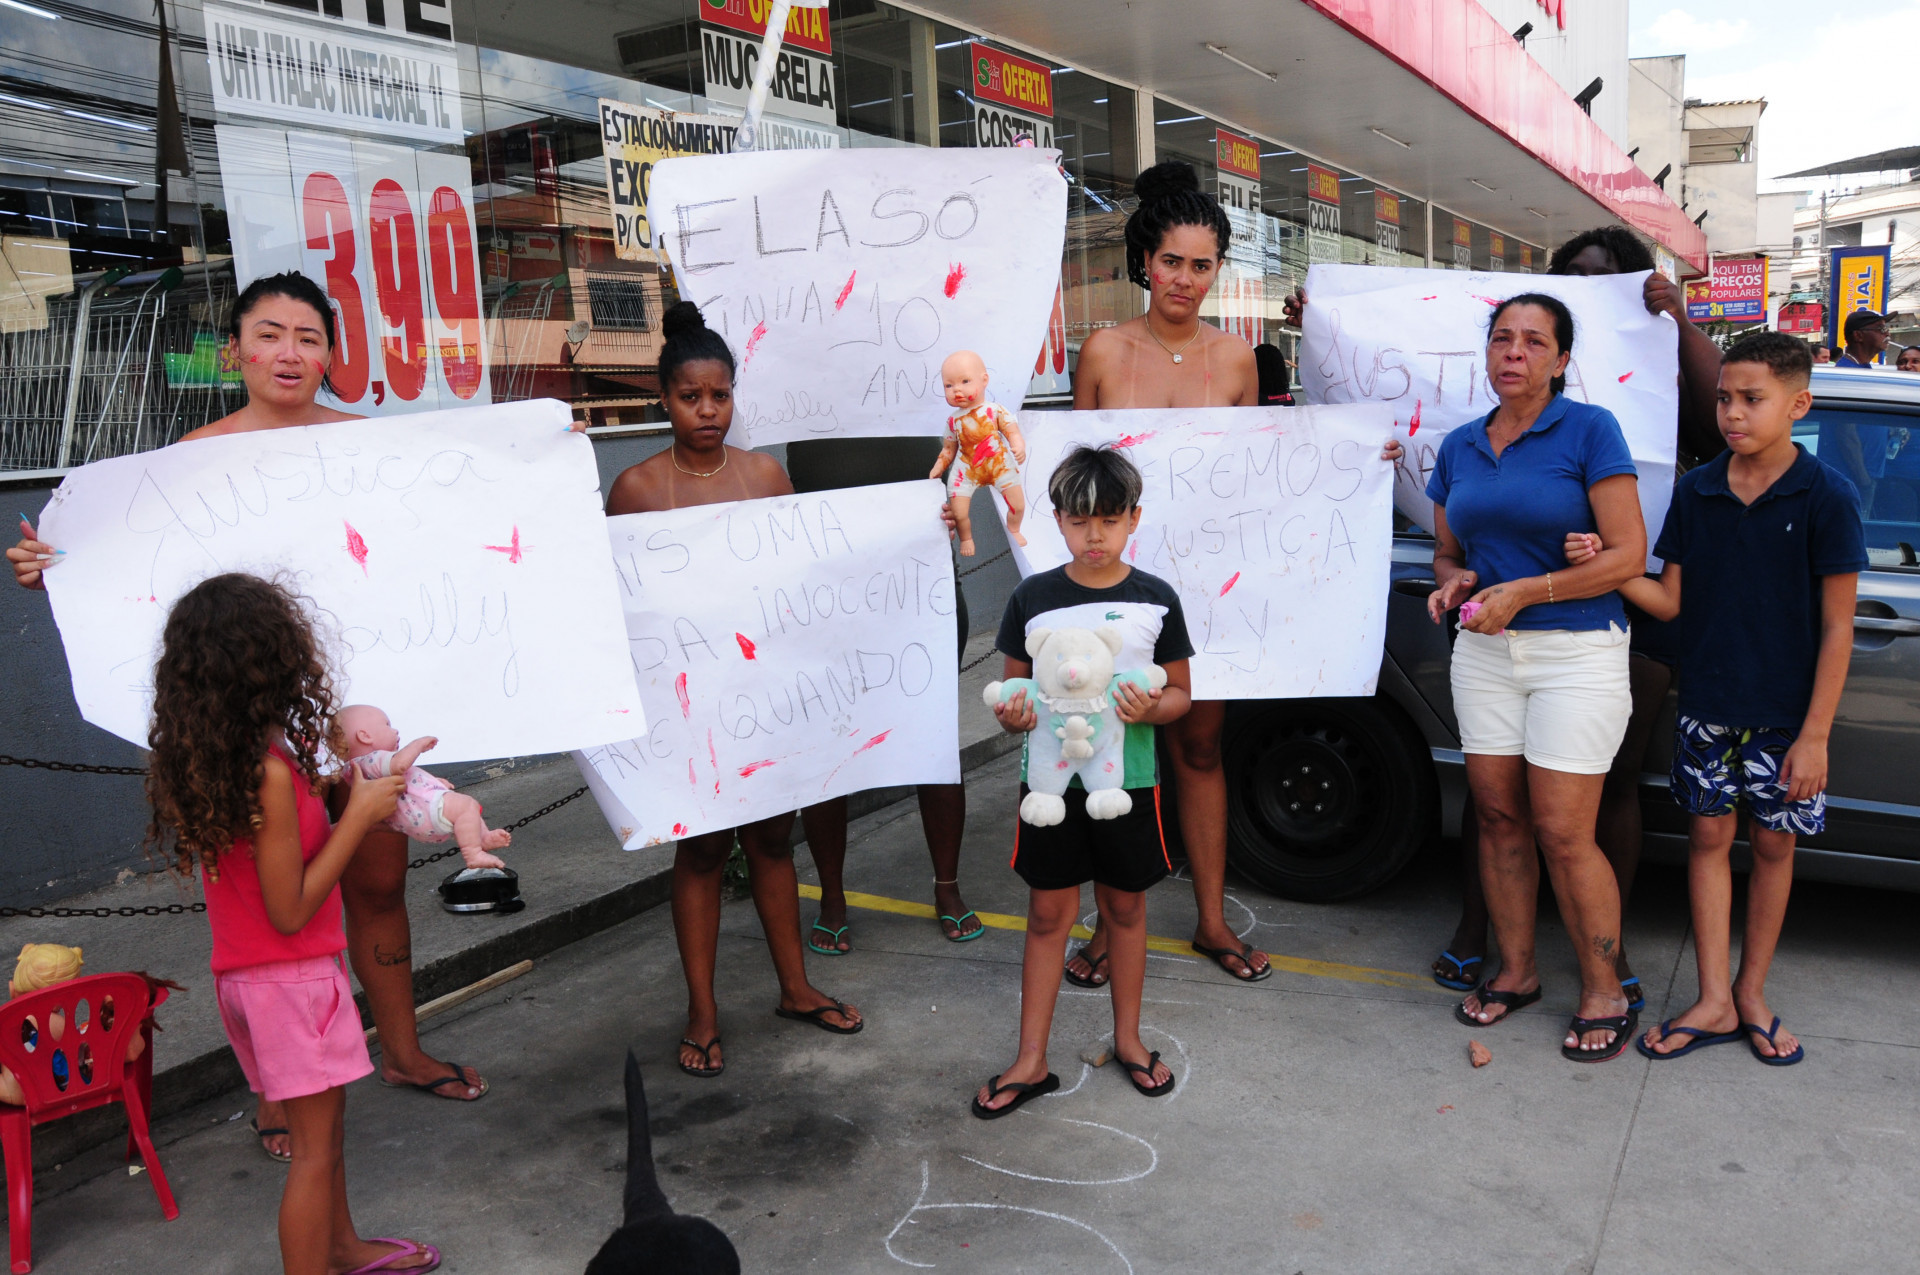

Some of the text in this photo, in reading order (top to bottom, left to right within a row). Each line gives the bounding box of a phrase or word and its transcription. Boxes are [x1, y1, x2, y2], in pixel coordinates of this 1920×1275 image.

[215, 22, 261, 100] UHT
[264, 32, 336, 112] ITALAC
[337, 46, 428, 126] INTEGRAL
[703, 32, 834, 110] MUCRELA
[1002, 61, 1048, 107] OFERTA
[1232, 141, 1258, 173] OFERTA
[610, 158, 653, 207] EXC
[1320, 172, 1339, 199] OFERTA
[1309, 202, 1339, 236] COXA
[1376, 223, 1399, 253] PEITO
[303, 171, 483, 406] 3,99
[1711, 275, 1762, 289] PREÇOS
[1712, 264, 1762, 275] AQUI TEM
[1710, 288, 1762, 298] POPULARES
[726, 500, 854, 562] UMA
[341, 572, 520, 698] aelly
[718, 642, 934, 741] QUANDO
